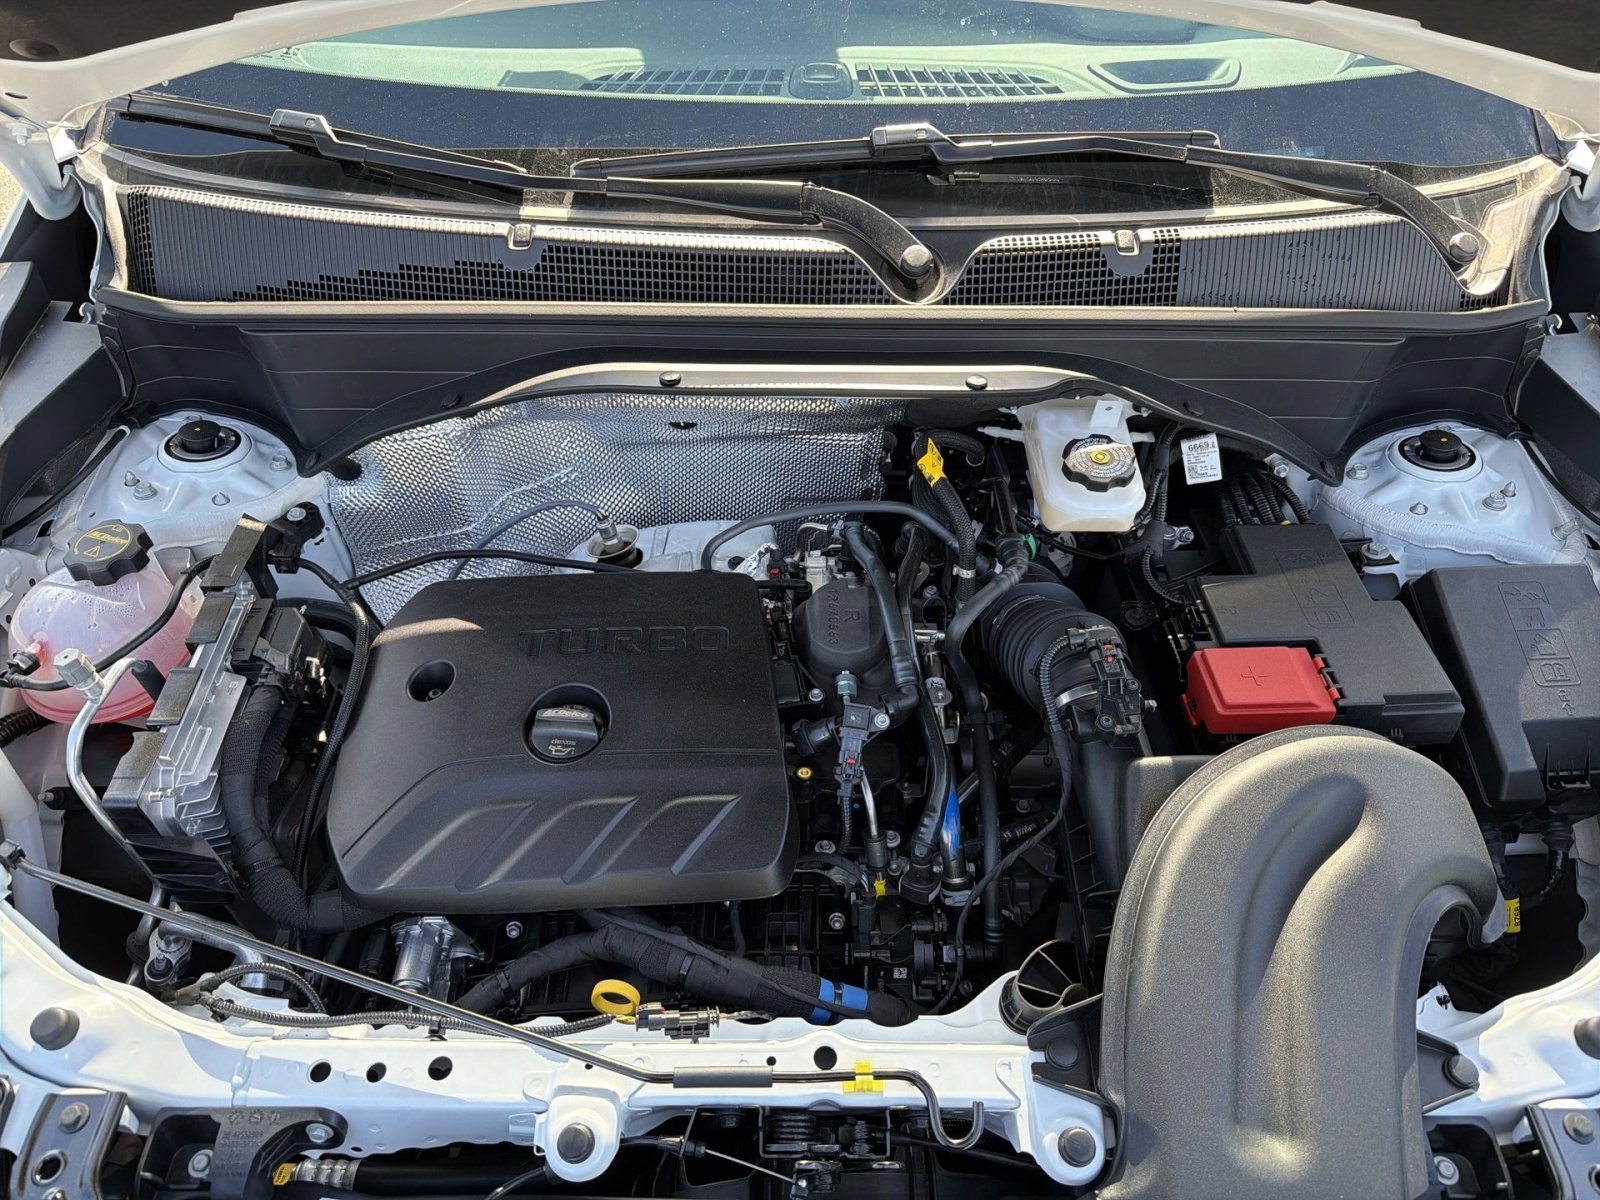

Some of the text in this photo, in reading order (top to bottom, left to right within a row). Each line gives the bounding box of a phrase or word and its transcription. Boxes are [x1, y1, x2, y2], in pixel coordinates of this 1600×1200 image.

[1188, 441, 1209, 451] 6669
[88, 531, 128, 544] ACDelco
[843, 609, 860, 622] R
[519, 626, 730, 656] TURBO
[543, 709, 589, 718] ACDelco
